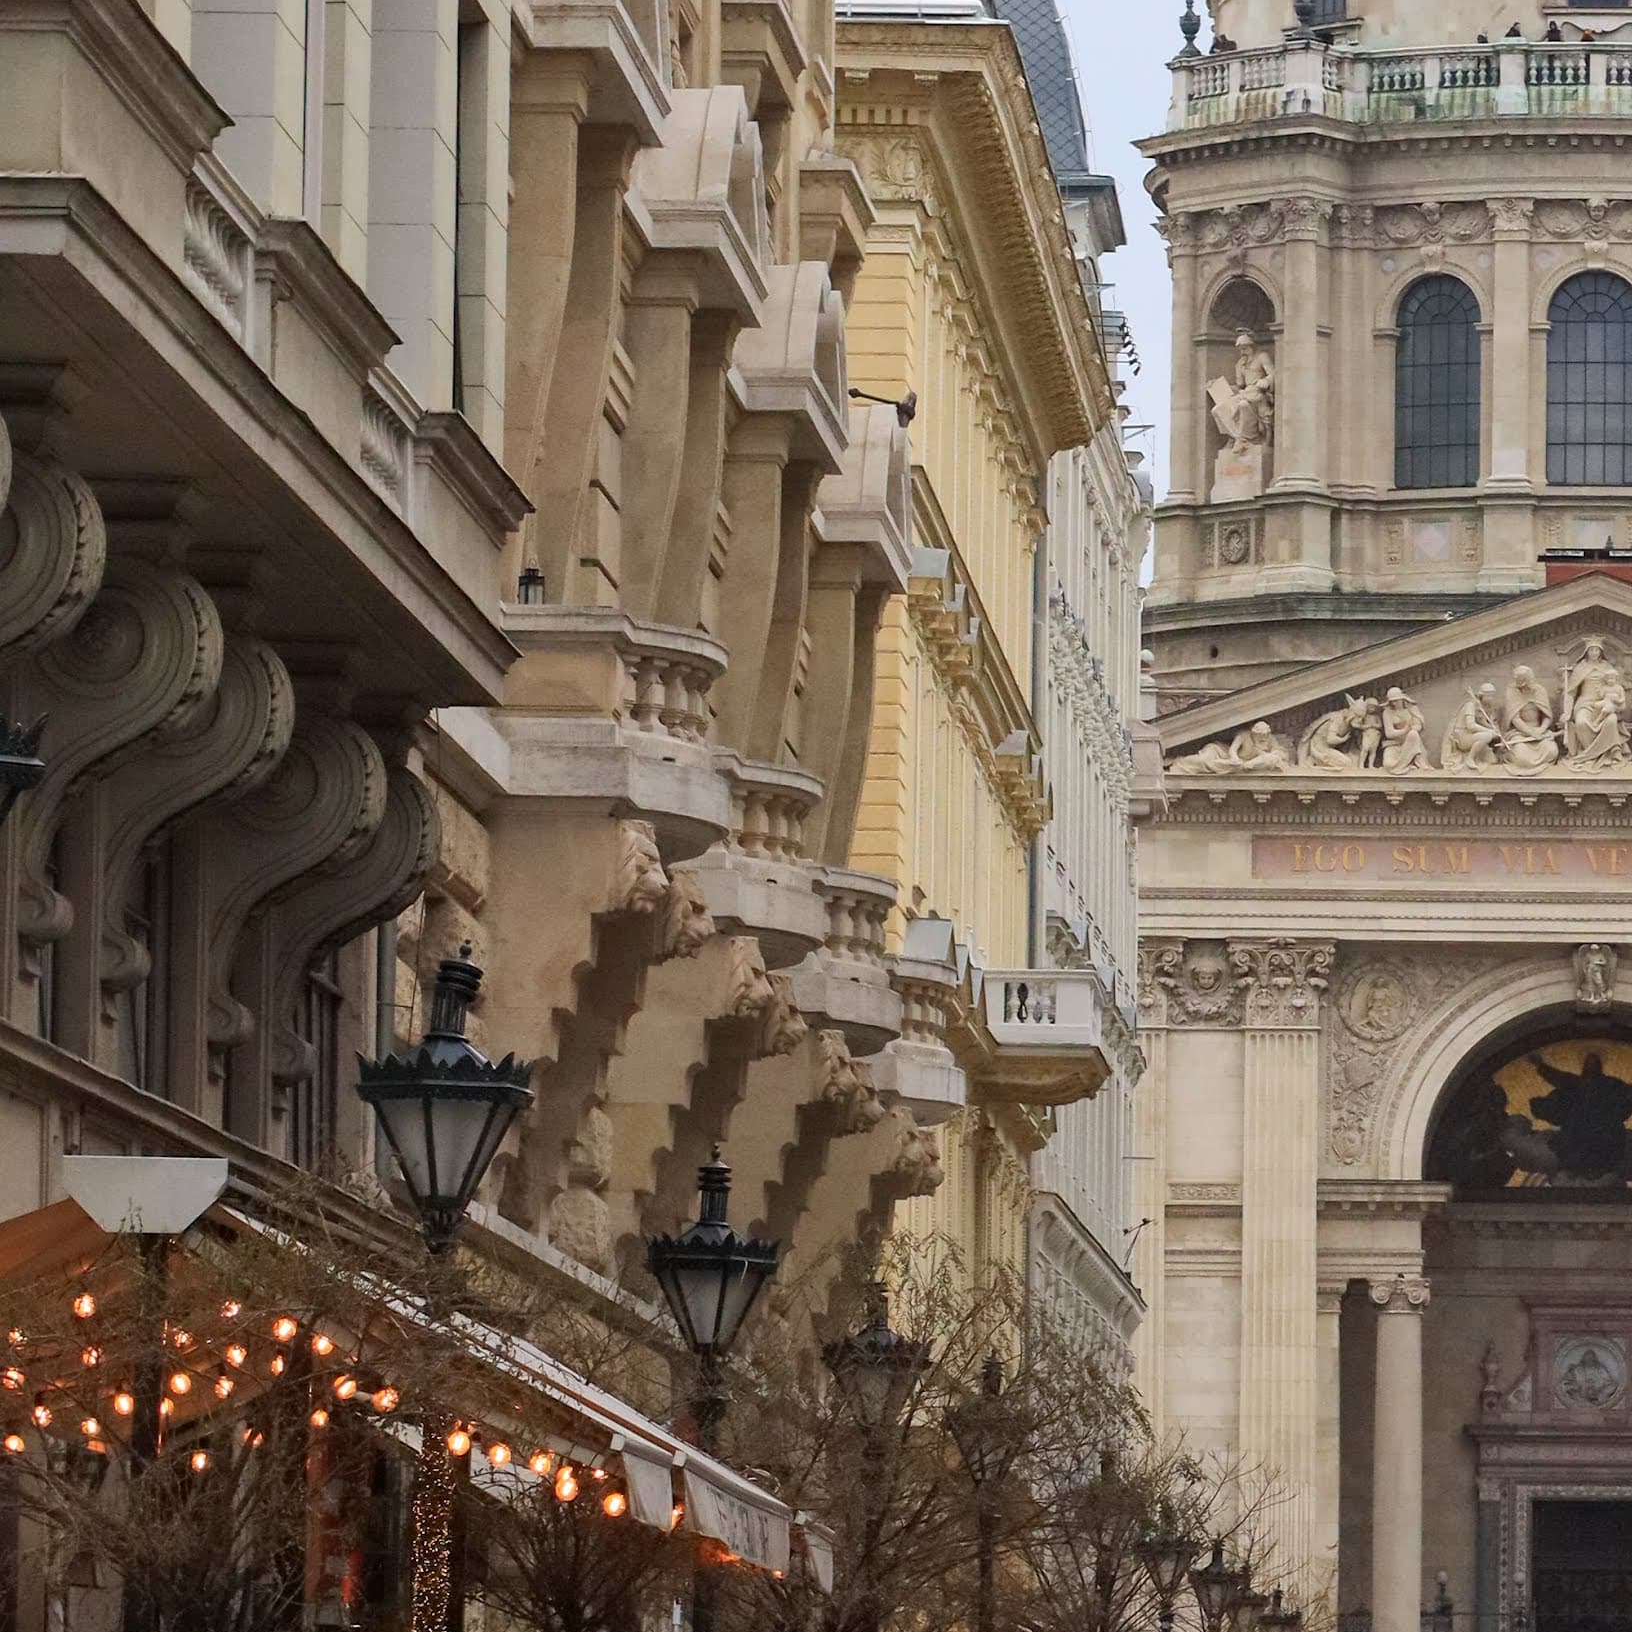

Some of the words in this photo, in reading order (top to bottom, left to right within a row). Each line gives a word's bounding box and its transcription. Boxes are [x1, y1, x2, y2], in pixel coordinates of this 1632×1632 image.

[1291, 844, 1366, 874] EGO
[1392, 844, 1471, 874] SUM
[1497, 845, 1562, 875] VIA
